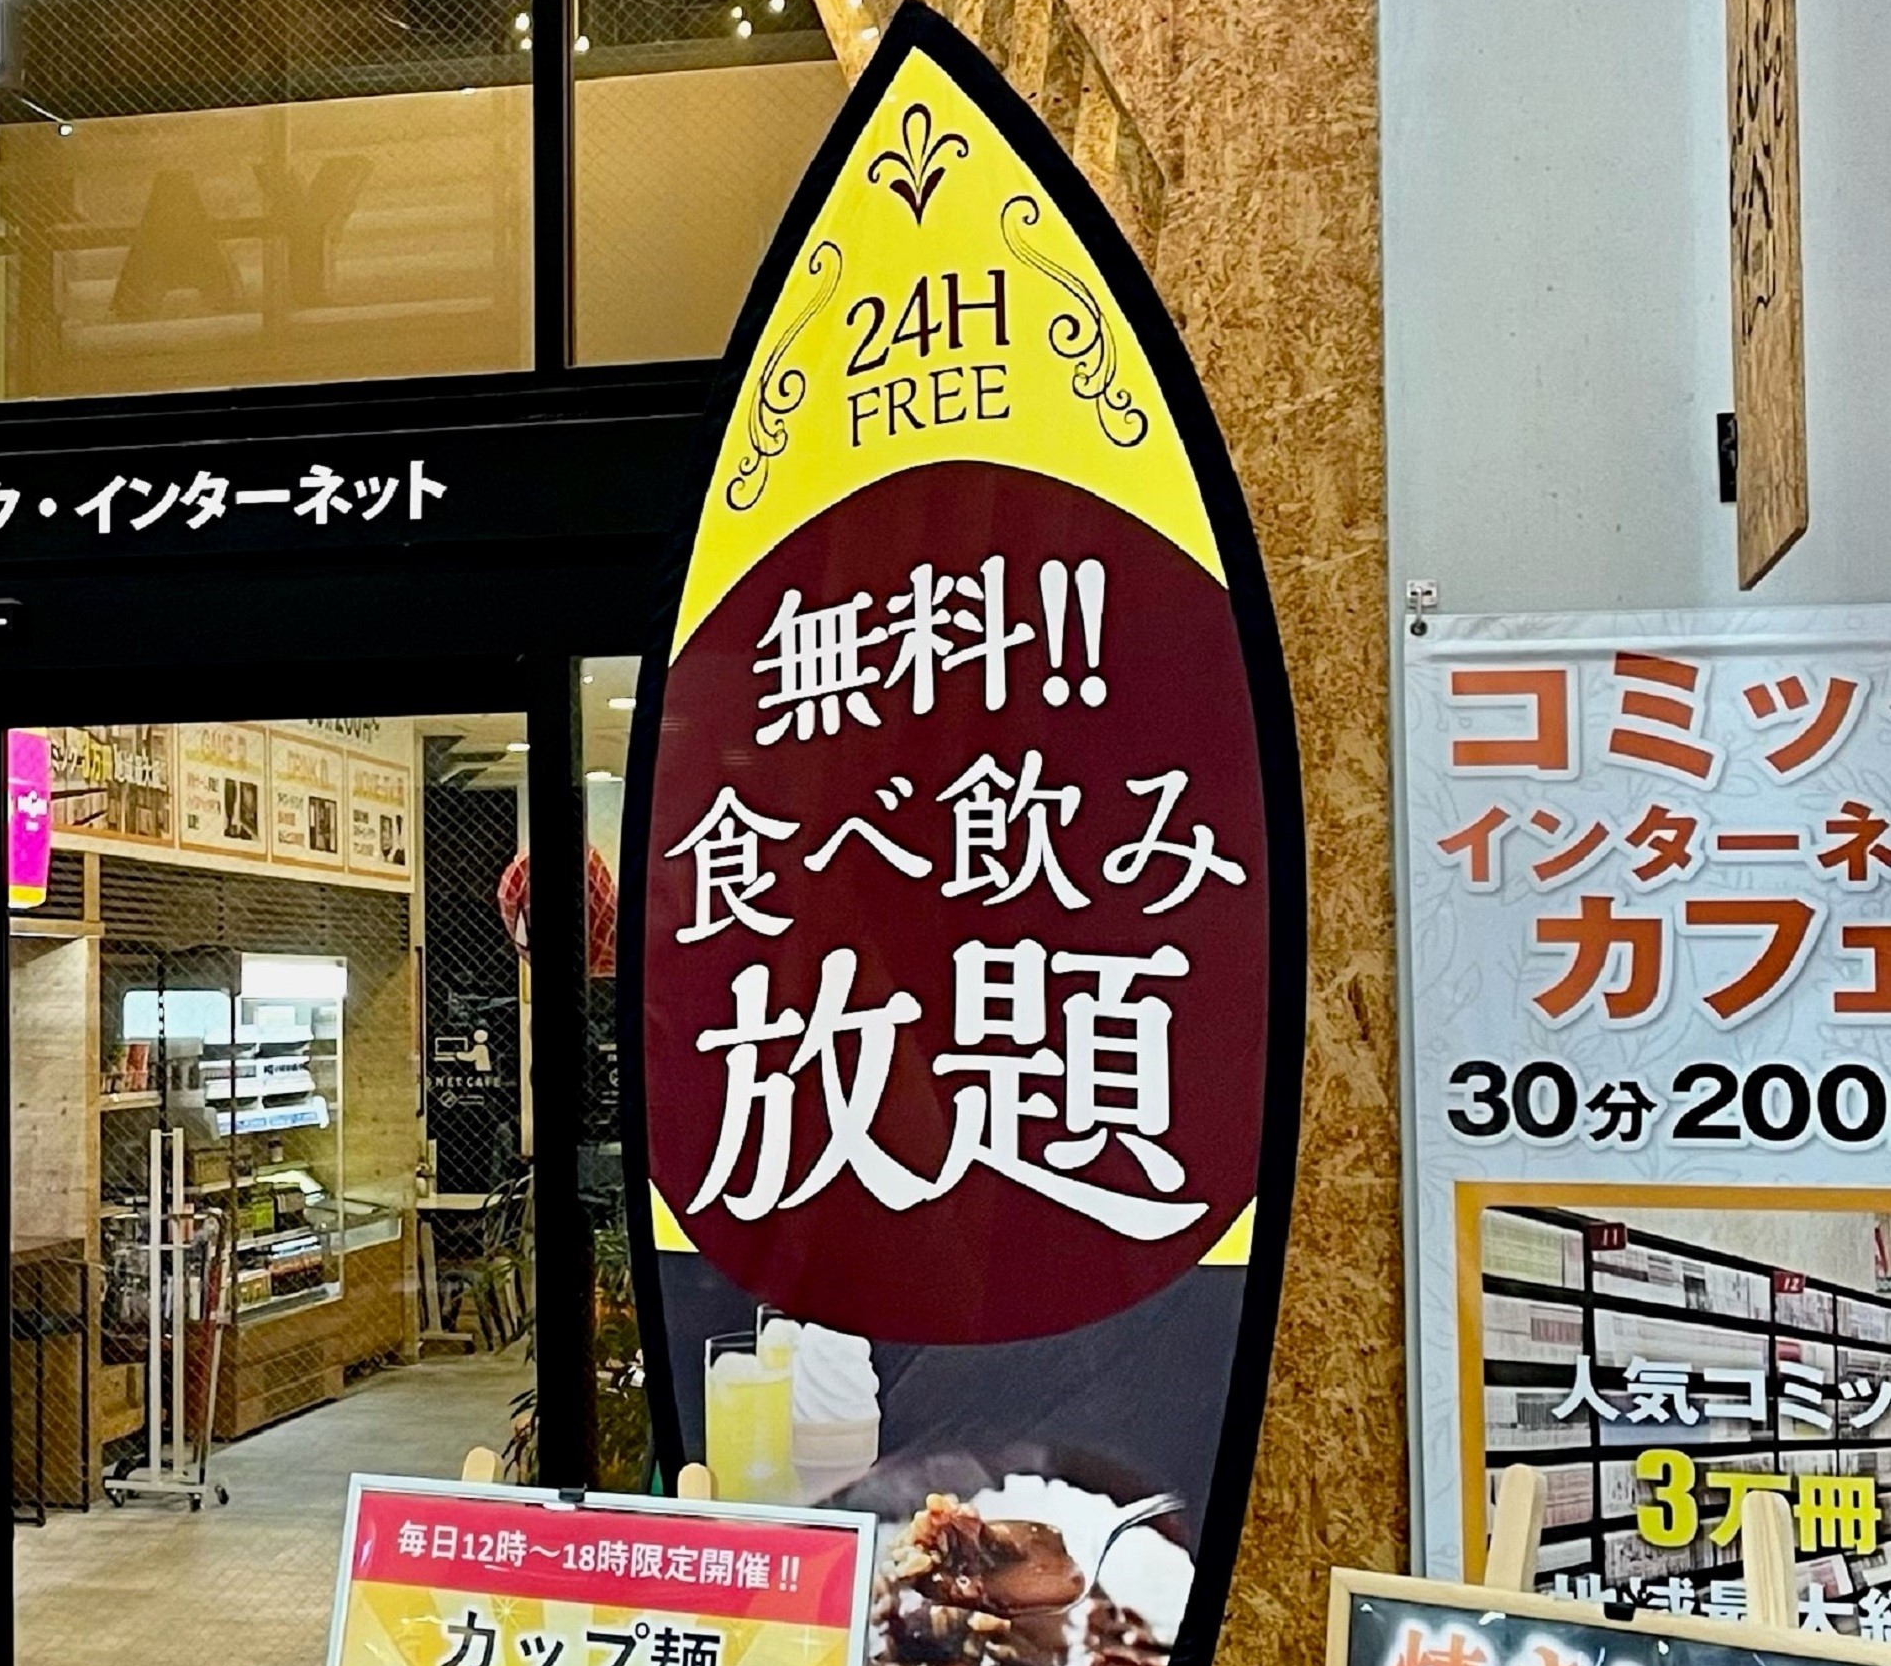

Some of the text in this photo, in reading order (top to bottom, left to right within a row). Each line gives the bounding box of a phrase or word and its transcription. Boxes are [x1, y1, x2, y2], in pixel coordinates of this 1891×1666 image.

[846, 270, 1009, 377] 24H
[848, 364, 1009, 447] FREE
[753, 556, 1107, 745] 無料!!
[665, 749, 1246, 943] 食べ飲み
[686, 938, 1209, 1240] 放題
